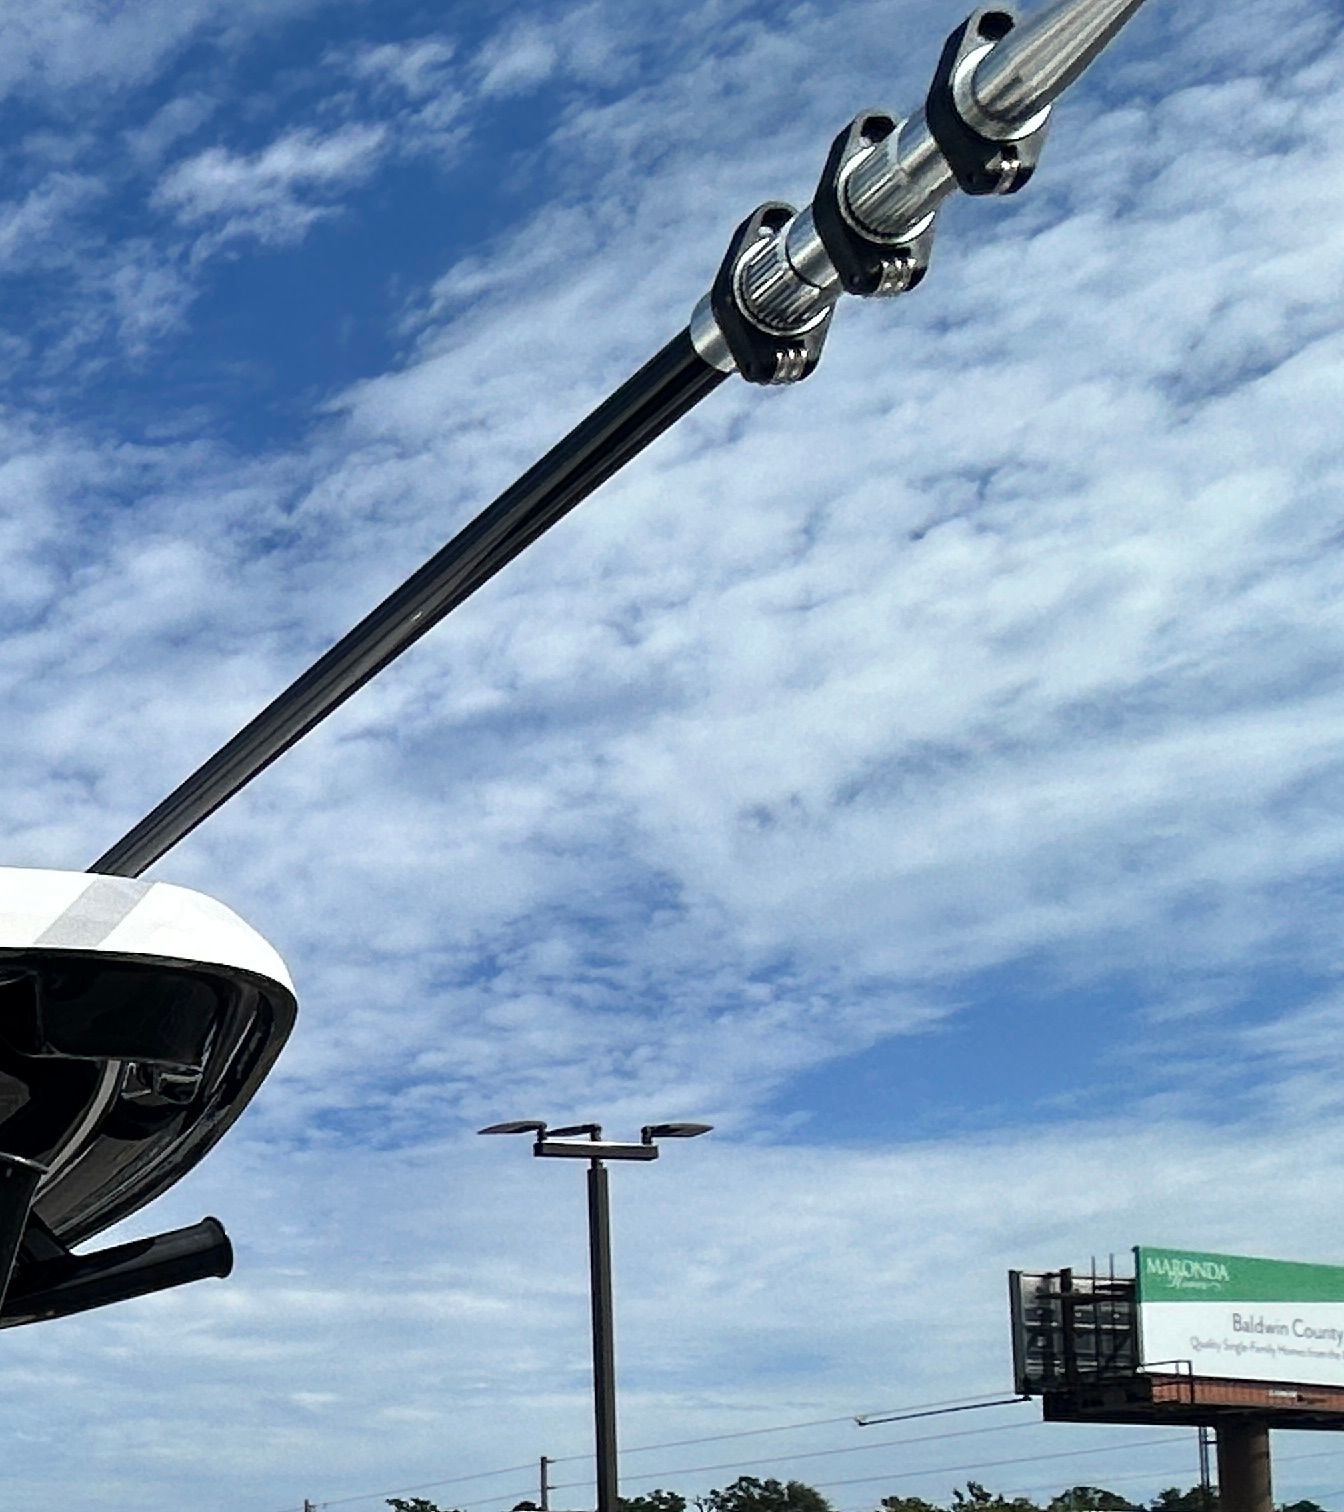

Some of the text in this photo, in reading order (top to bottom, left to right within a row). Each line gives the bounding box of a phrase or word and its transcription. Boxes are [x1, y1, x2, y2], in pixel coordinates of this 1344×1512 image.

[1146, 1257, 1230, 1282] MARONDA
[1232, 1312, 1344, 1346] Baldwin County
